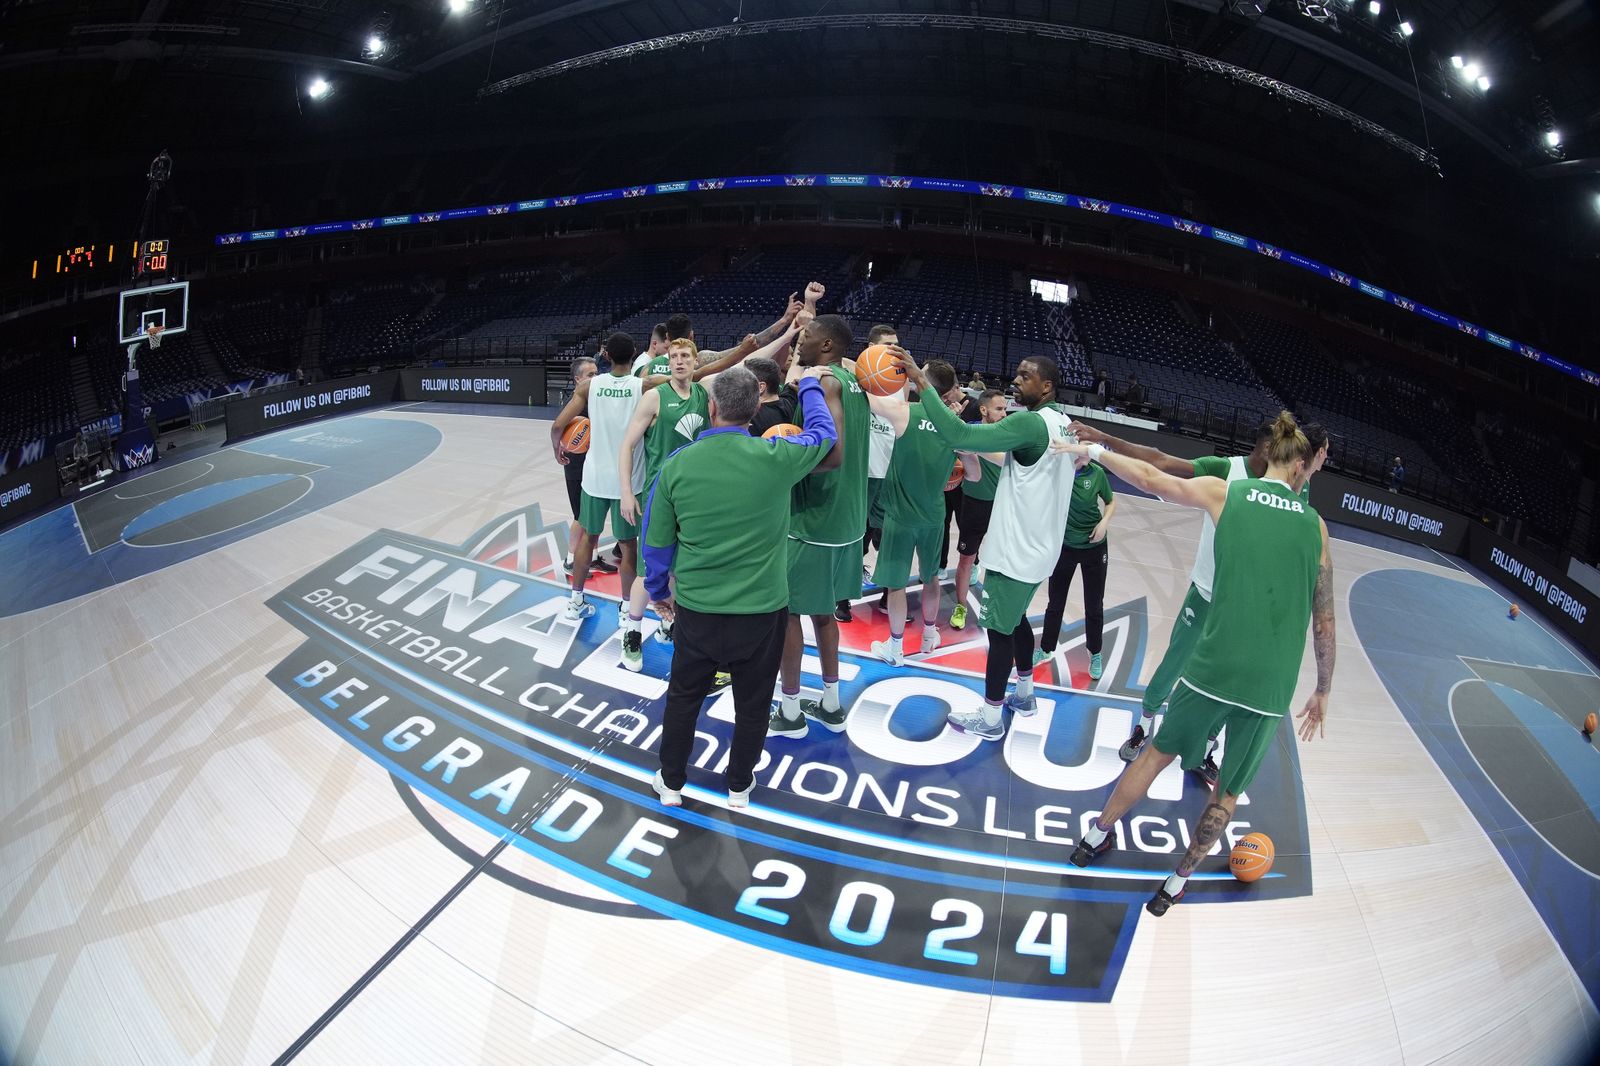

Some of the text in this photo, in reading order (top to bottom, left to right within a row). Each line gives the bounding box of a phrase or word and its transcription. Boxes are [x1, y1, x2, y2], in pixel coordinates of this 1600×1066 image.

[263, 384, 371, 419] FOLLOW US ON @FIBAIC
[421, 378, 510, 393] FOLLOW US ON @FIBAIC
[80, 416, 118, 434] FINAL
[571, 424, 589, 446] Wilson
[870, 420, 890, 432] icaja
[0, 482, 31, 507] @FIBAIC
[1341, 492, 1443, 536] FOLLOW US ON @FIBAIC
[1490, 547, 1587, 624] FOLLOW US ON @FIBAIC
[335, 545, 669, 700] FINAL
[302, 588, 509, 696] BASKETBALL
[293, 660, 1068, 975] BELGRADE 2024
